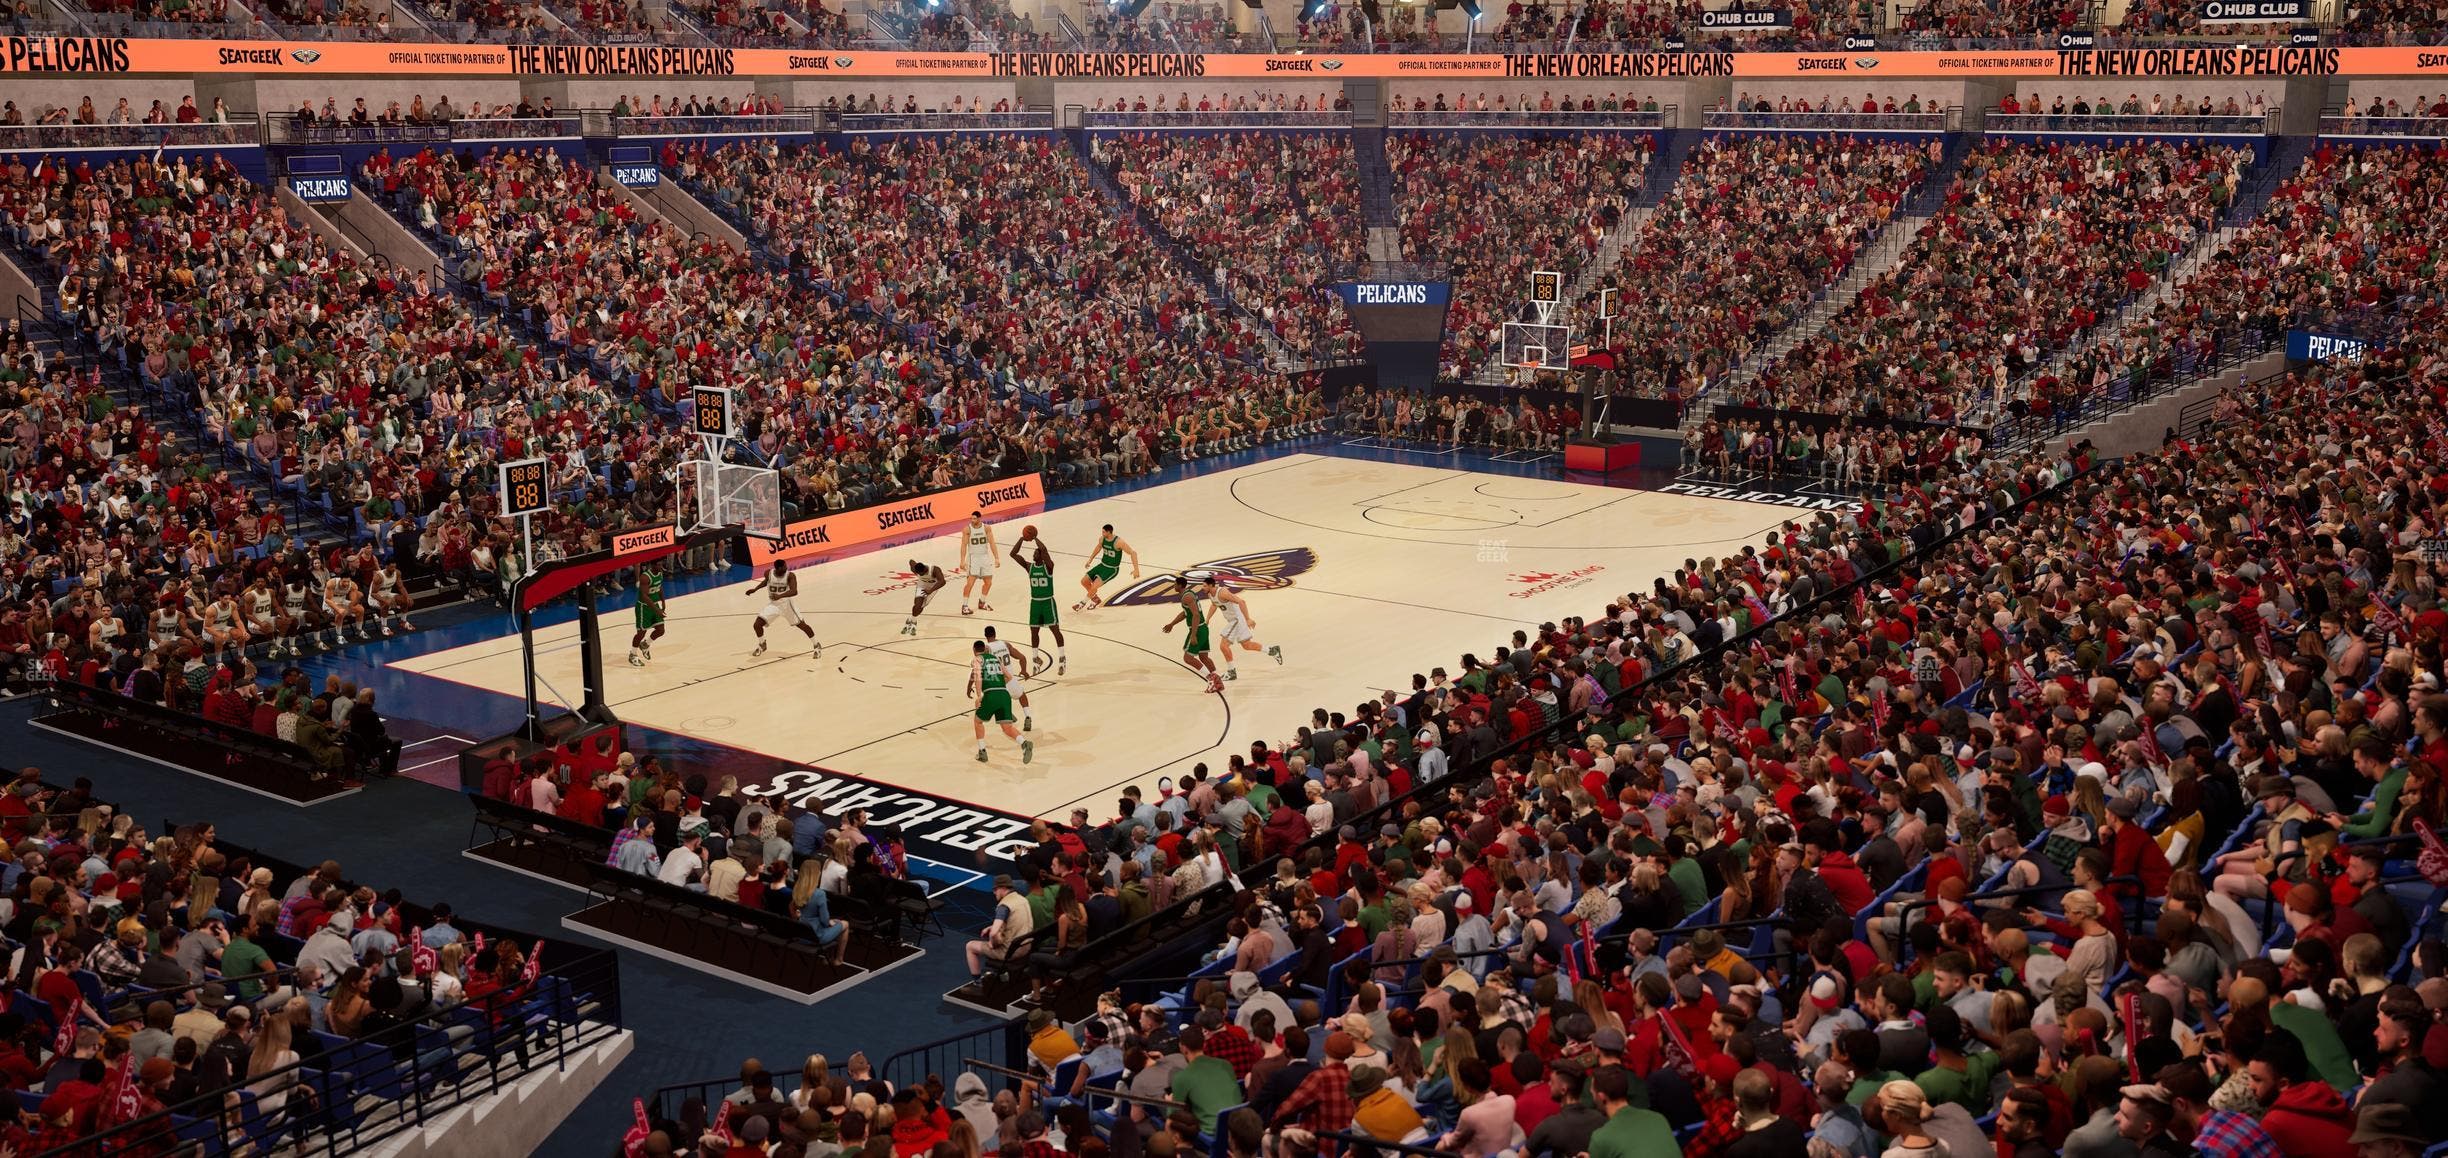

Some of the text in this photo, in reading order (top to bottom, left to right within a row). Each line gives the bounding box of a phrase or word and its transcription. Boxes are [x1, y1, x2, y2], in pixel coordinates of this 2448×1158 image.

[1717, 12, 1775, 24] HUB CLUB
[2225, 2, 2299, 16] HUB CLUB
[1856, 39, 1875, 48] HUB
[2072, 36, 2093, 46] HUB
[2302, 34, 2318, 43] HUB
[11, 37, 130, 71] PELICANS
[219, 48, 284, 66] SEATGEEK
[389, 46, 735, 75] OFFICIAL TICKETING PARTNER OF THE NEW ORLEANS PELICANS
[789, 56, 829, 70] SEATGEEK
[1938, 48, 2340, 75] OFFICIAL TICKETING PARTNER OF THE NEW ORLEANS PELICANS
[2417, 53, 2448, 67] SEAT
[895, 53, 1205, 76] OFFICIAL TICKETING PARTNER OF THE NEW ORLEANS PELICANS
[1265, 59, 1313, 72] SEATGEEK
[1398, 54, 1734, 77] OFFICIAL TICKETING PARTNER OF THE NEW ORLEANS PELICANS
[1798, 58, 1847, 70] SEATGEEK
[617, 168, 657, 183] PELICANS
[295, 180, 348, 198] PELICANS
[1357, 284, 1427, 303] PELICANS
[1538, 286, 1552, 299] 88
[698, 393, 723, 407] 88 88
[702, 409, 721, 430] 88
[511, 465, 541, 482] 88 88
[516, 482, 538, 509] 88
[977, 483, 1030, 508] SEATGEEK
[1657, 482, 1864, 513] PELICANS
[877, 502, 935, 530] SEATGEEK
[620, 530, 669, 552] SEATGEEK
[768, 525, 830, 555] SEATGEEK
[560, 763, 571, 784] 00
[741, 770, 1041, 862] PELICANS
